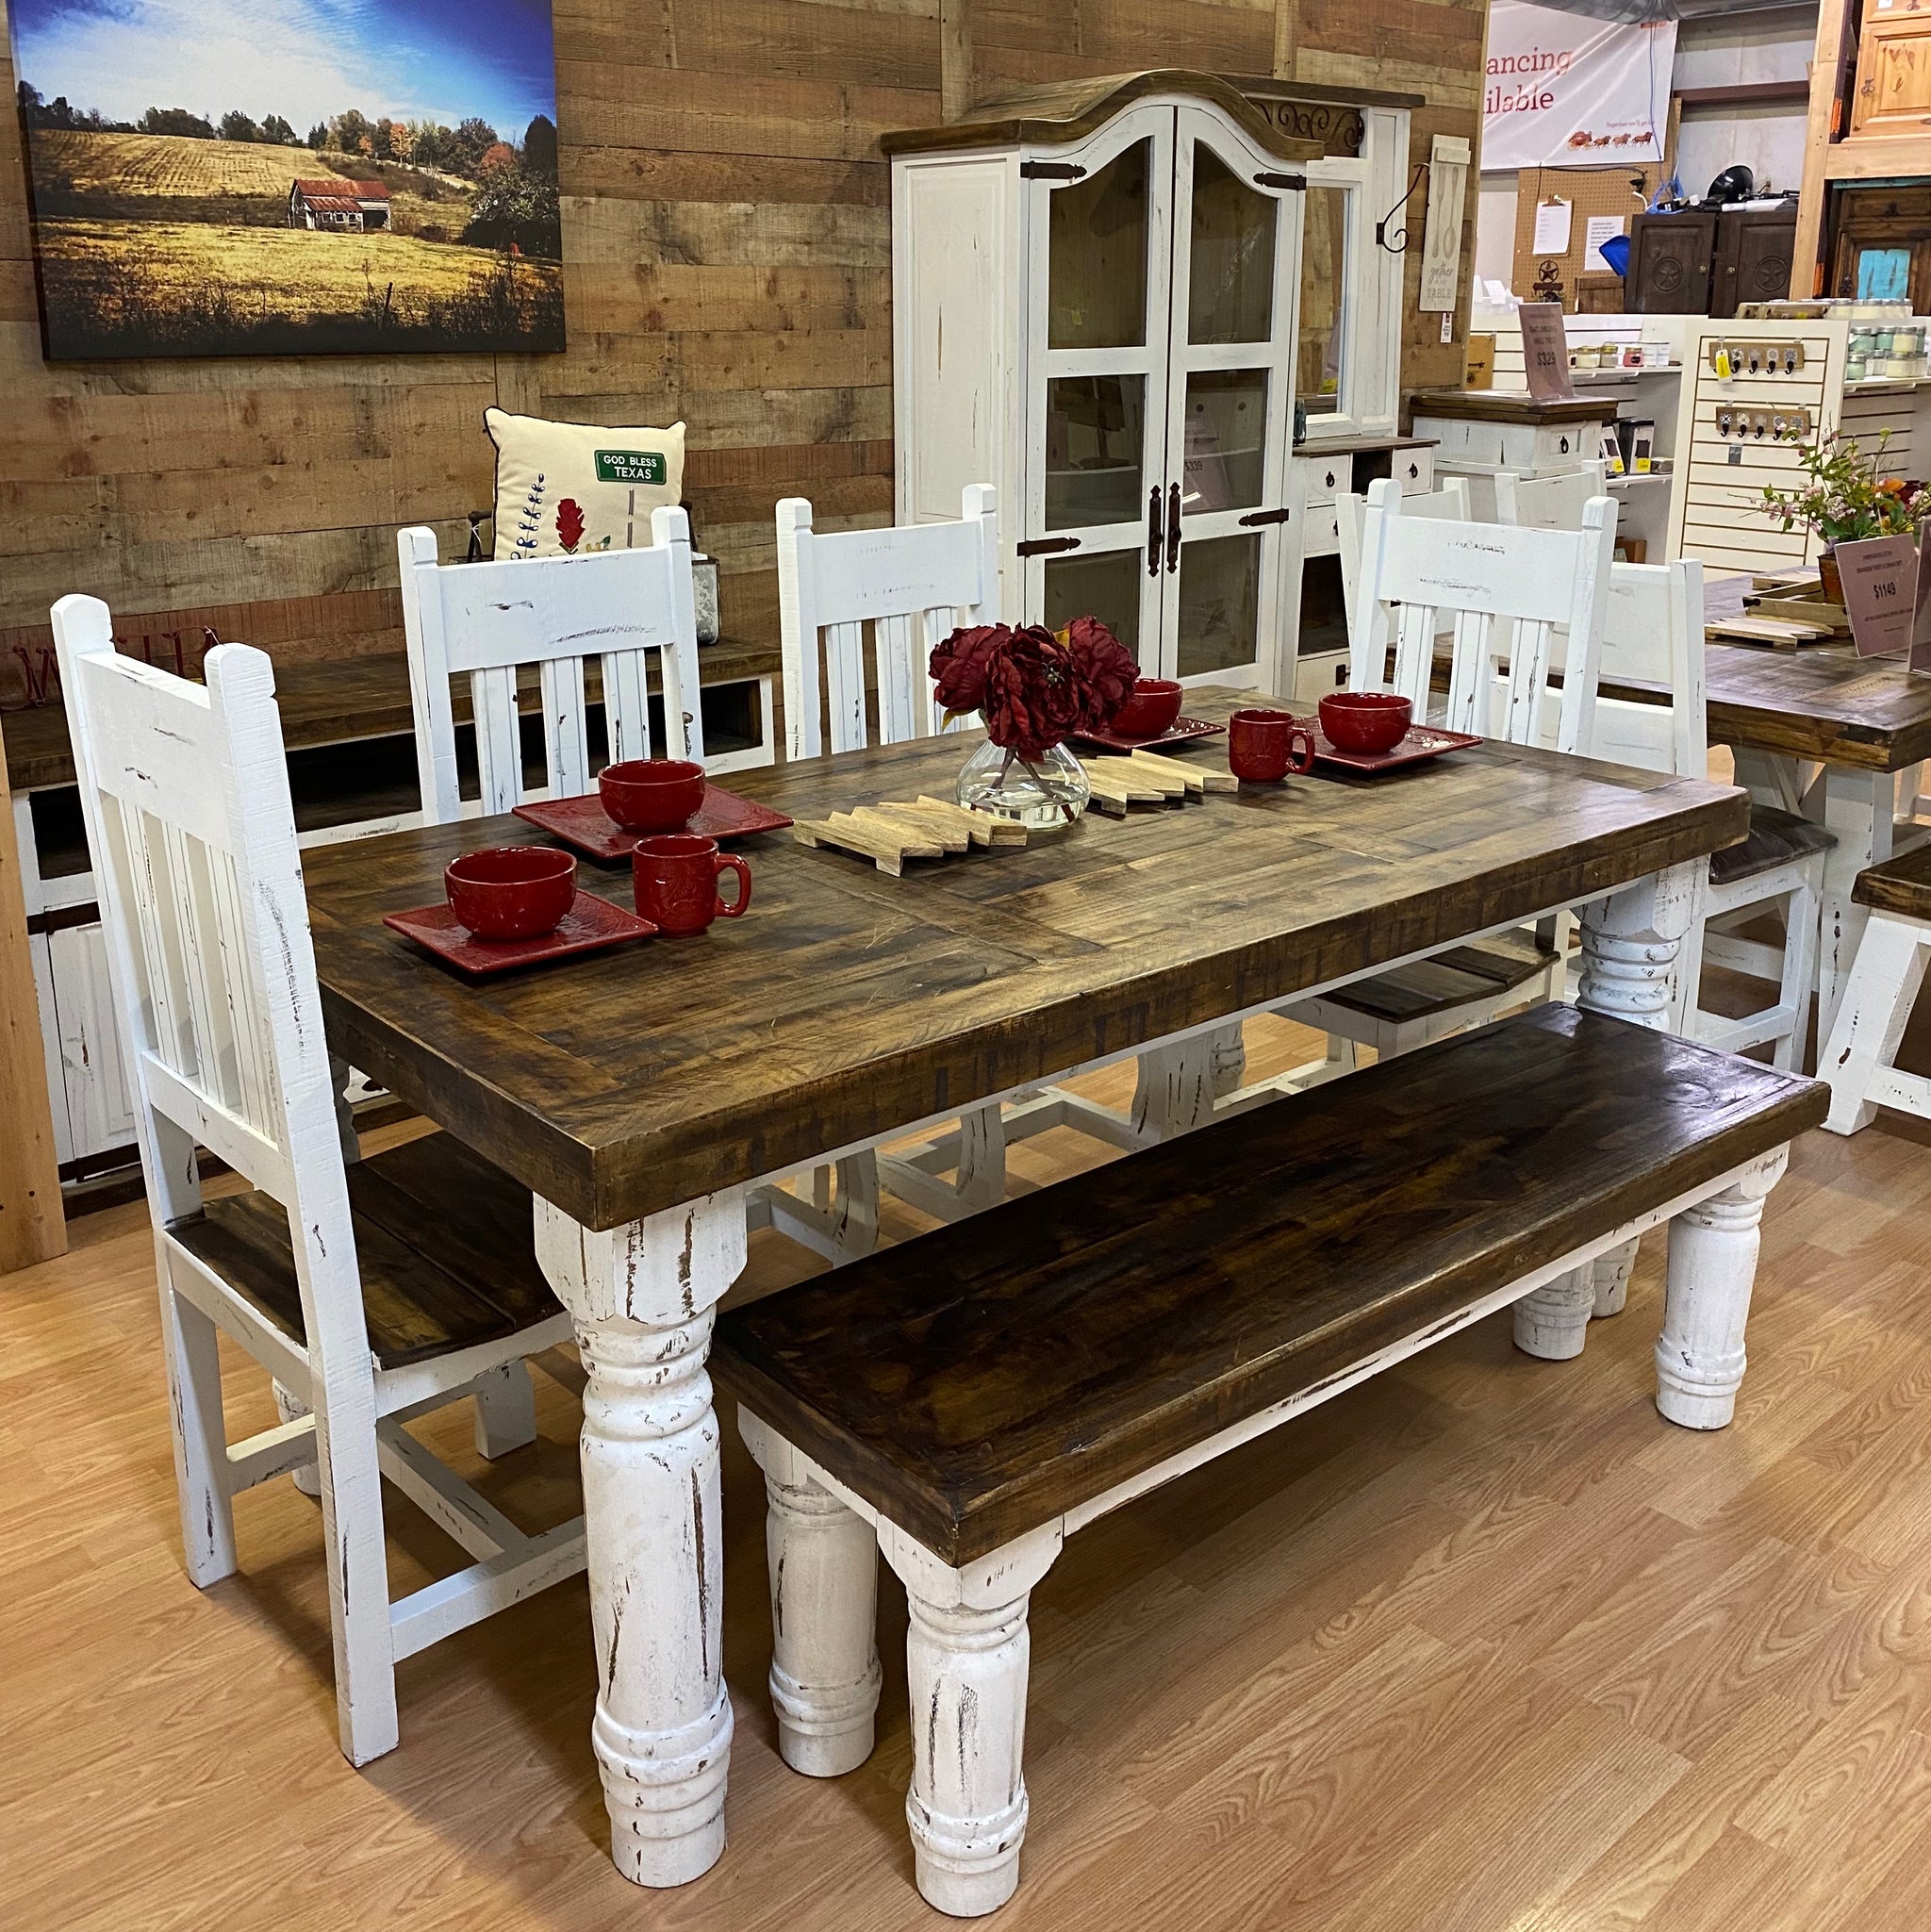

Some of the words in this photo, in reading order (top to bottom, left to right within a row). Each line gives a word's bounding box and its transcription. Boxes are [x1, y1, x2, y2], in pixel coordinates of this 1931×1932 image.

[1483, 84, 1554, 114] ilable
[1427, 288, 1452, 299] TABLE
[603, 454, 626, 465] GOD
[629, 456, 657, 468] BLESS
[614, 466, 652, 480] TEXAS
[1873, 582, 1897, 601] $1149
